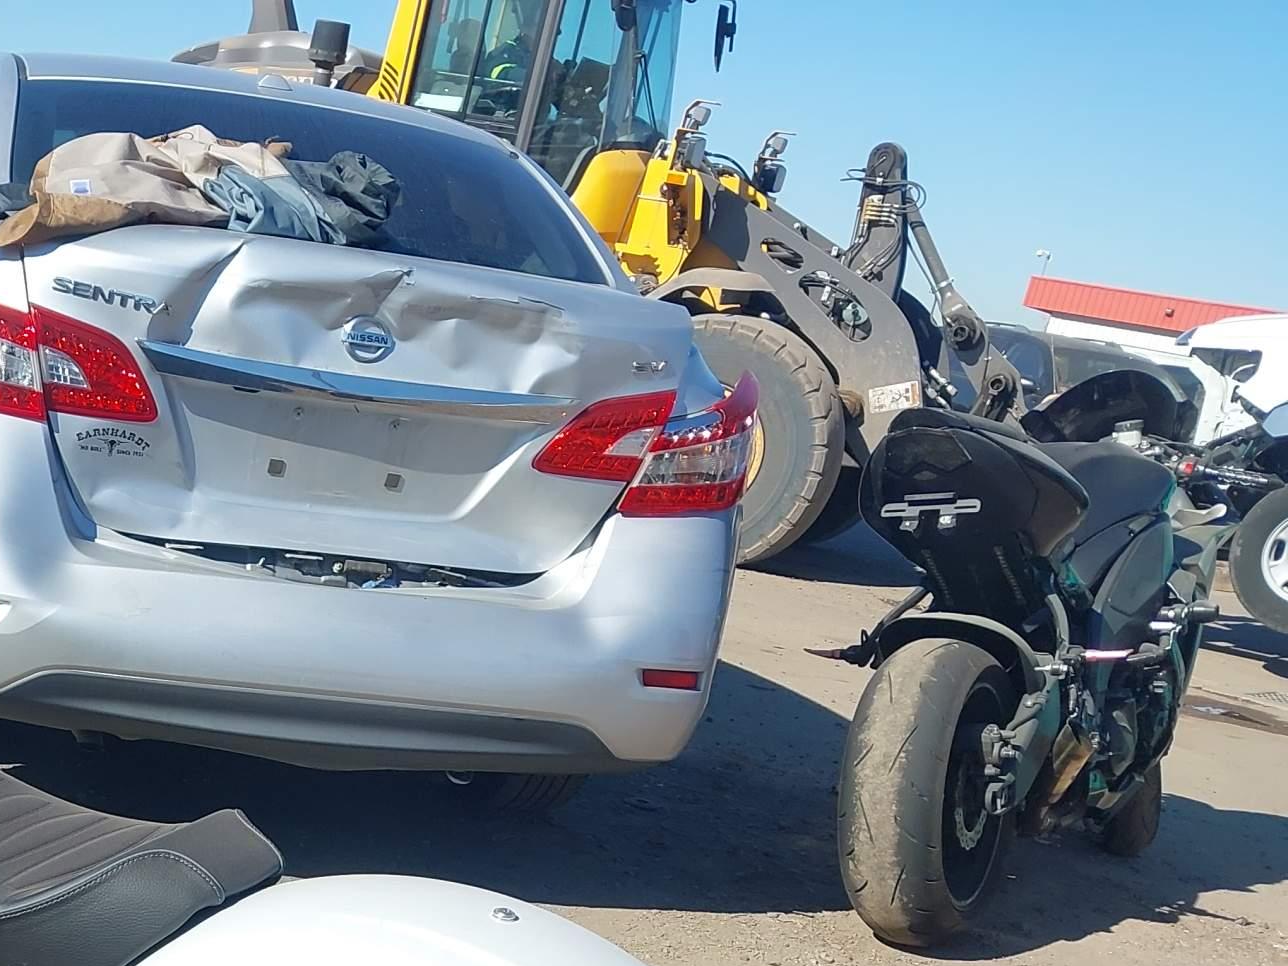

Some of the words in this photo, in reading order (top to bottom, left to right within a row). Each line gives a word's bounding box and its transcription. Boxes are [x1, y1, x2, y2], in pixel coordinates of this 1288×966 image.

[52, 276, 170, 315] SENTRA
[347, 332, 389, 346] NISSAN
[76, 427, 150, 451] EARNHARDT
